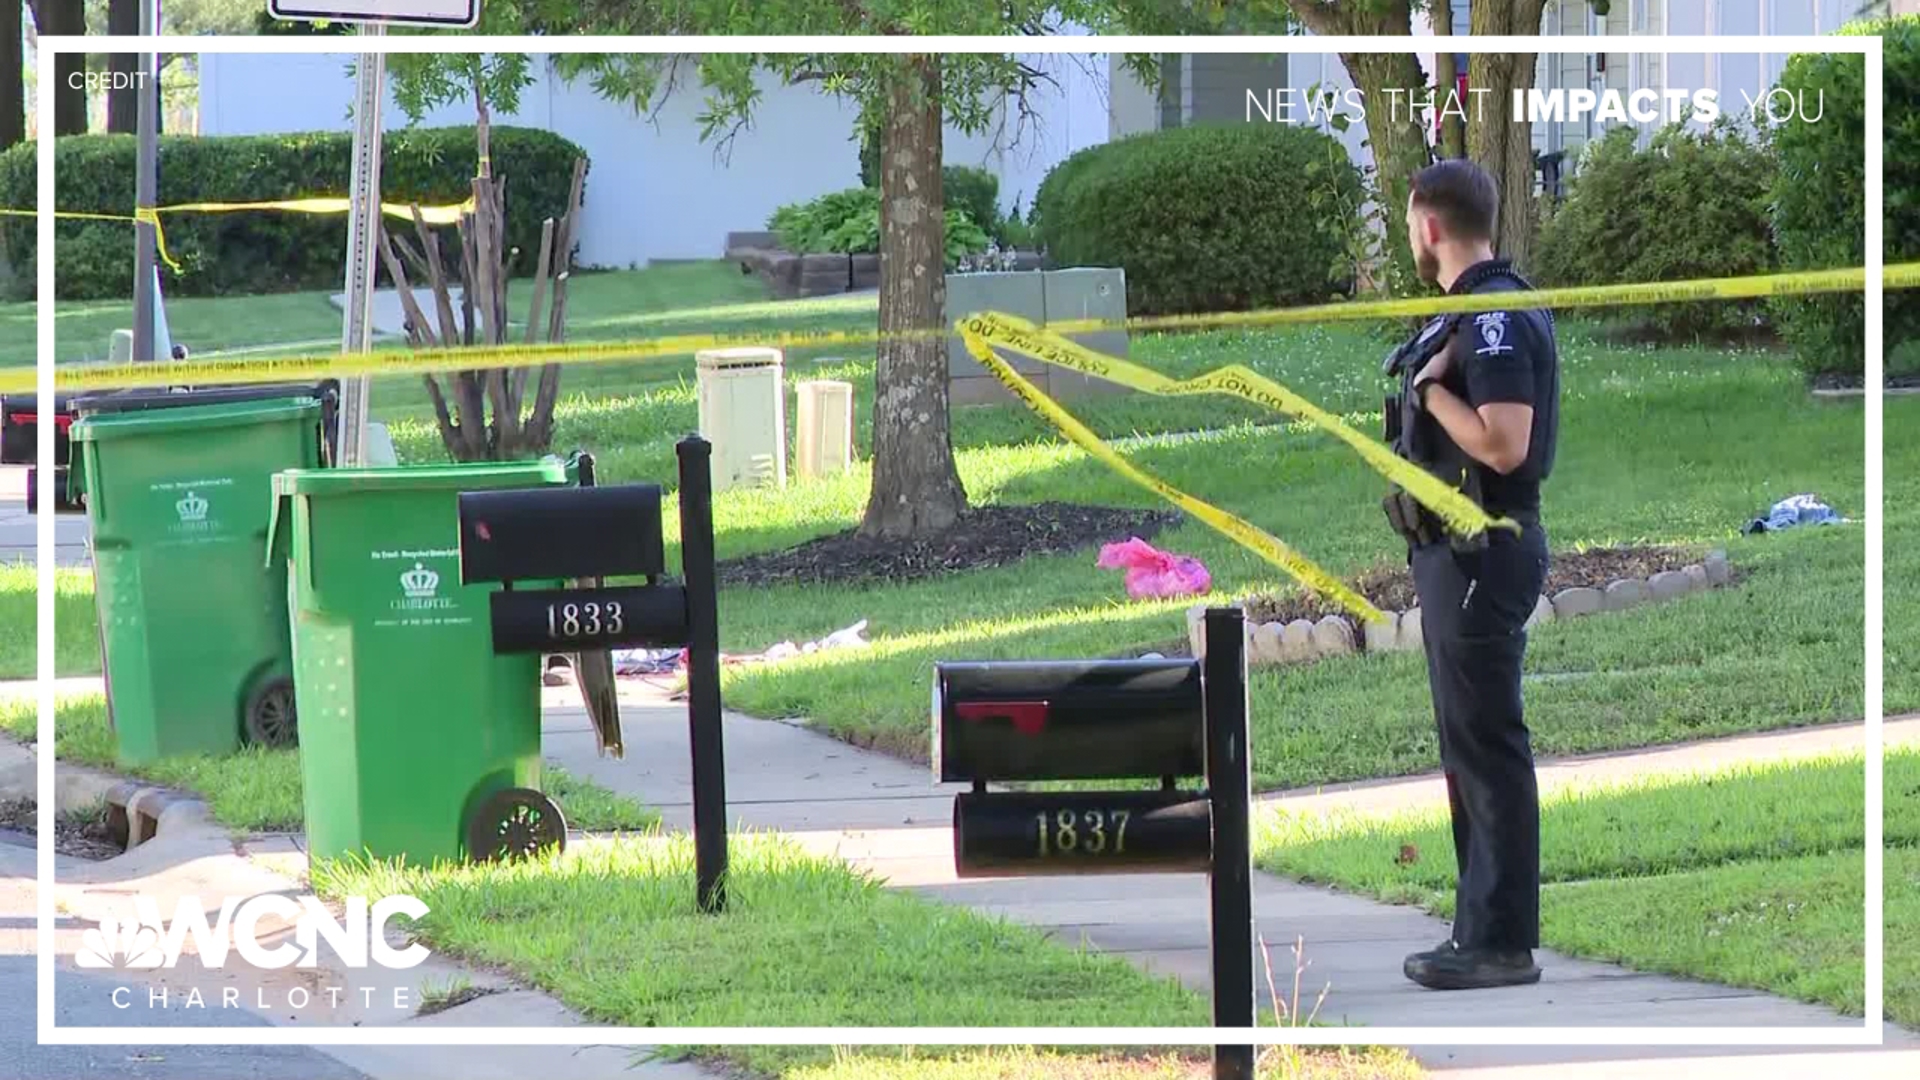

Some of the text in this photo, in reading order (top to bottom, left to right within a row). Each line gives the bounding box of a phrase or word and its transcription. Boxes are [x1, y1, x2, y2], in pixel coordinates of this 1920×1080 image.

[969, 318, 995, 337] DO
[1215, 378, 1254, 397] NOT
[1258, 390, 1283, 410] DO
[547, 601, 623, 638] 1833
[1036, 809, 1131, 856] 1837
